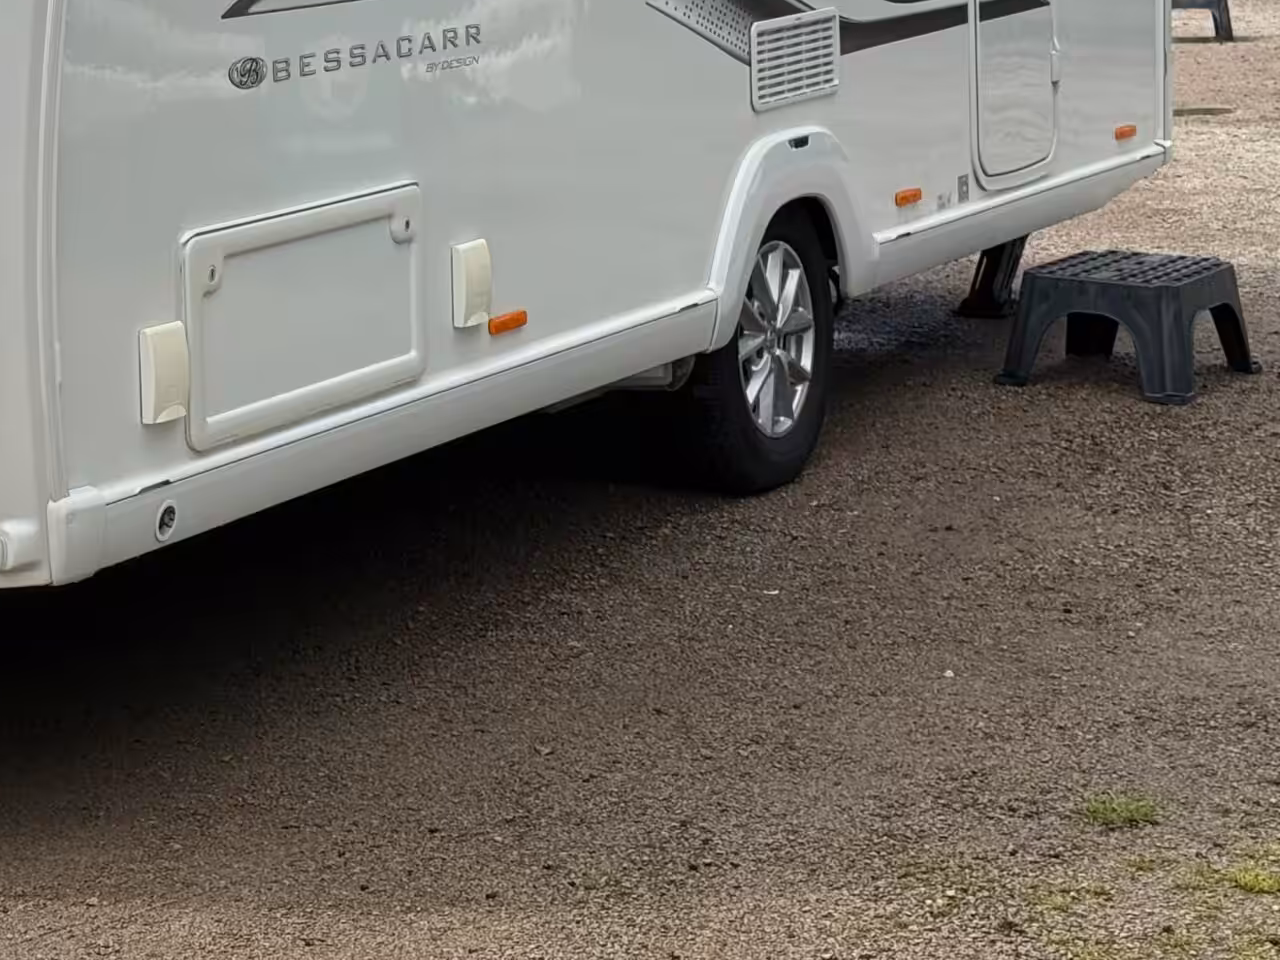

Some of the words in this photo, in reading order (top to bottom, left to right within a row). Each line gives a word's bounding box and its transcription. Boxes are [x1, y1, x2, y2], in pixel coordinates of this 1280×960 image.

[272, 23, 482, 83] BESSACARR
[425, 62, 439, 73] BY
[441, 55, 481, 70] DESIGN
